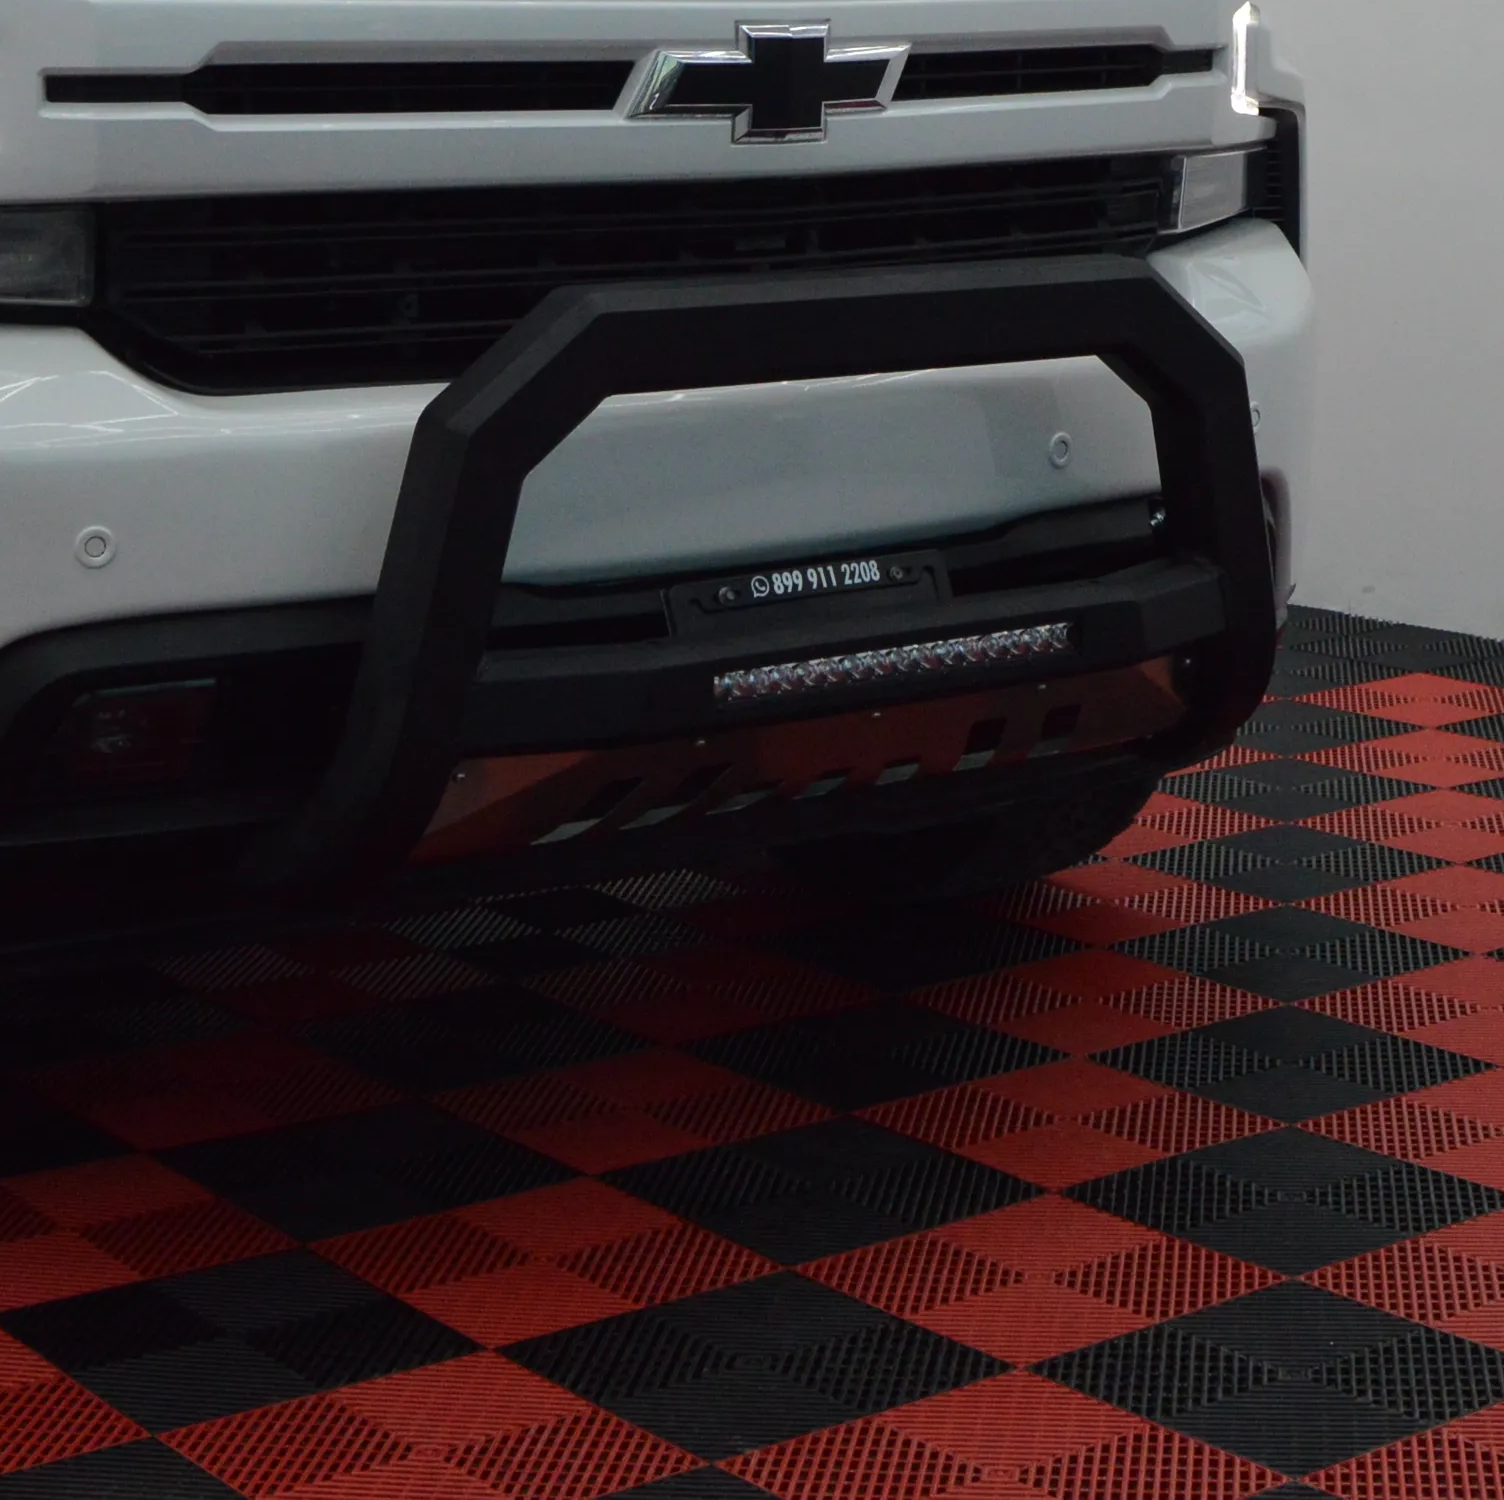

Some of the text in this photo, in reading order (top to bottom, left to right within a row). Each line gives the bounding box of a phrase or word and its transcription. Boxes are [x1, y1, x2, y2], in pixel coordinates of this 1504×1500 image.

[771, 559, 881, 595] 899 911 2208
